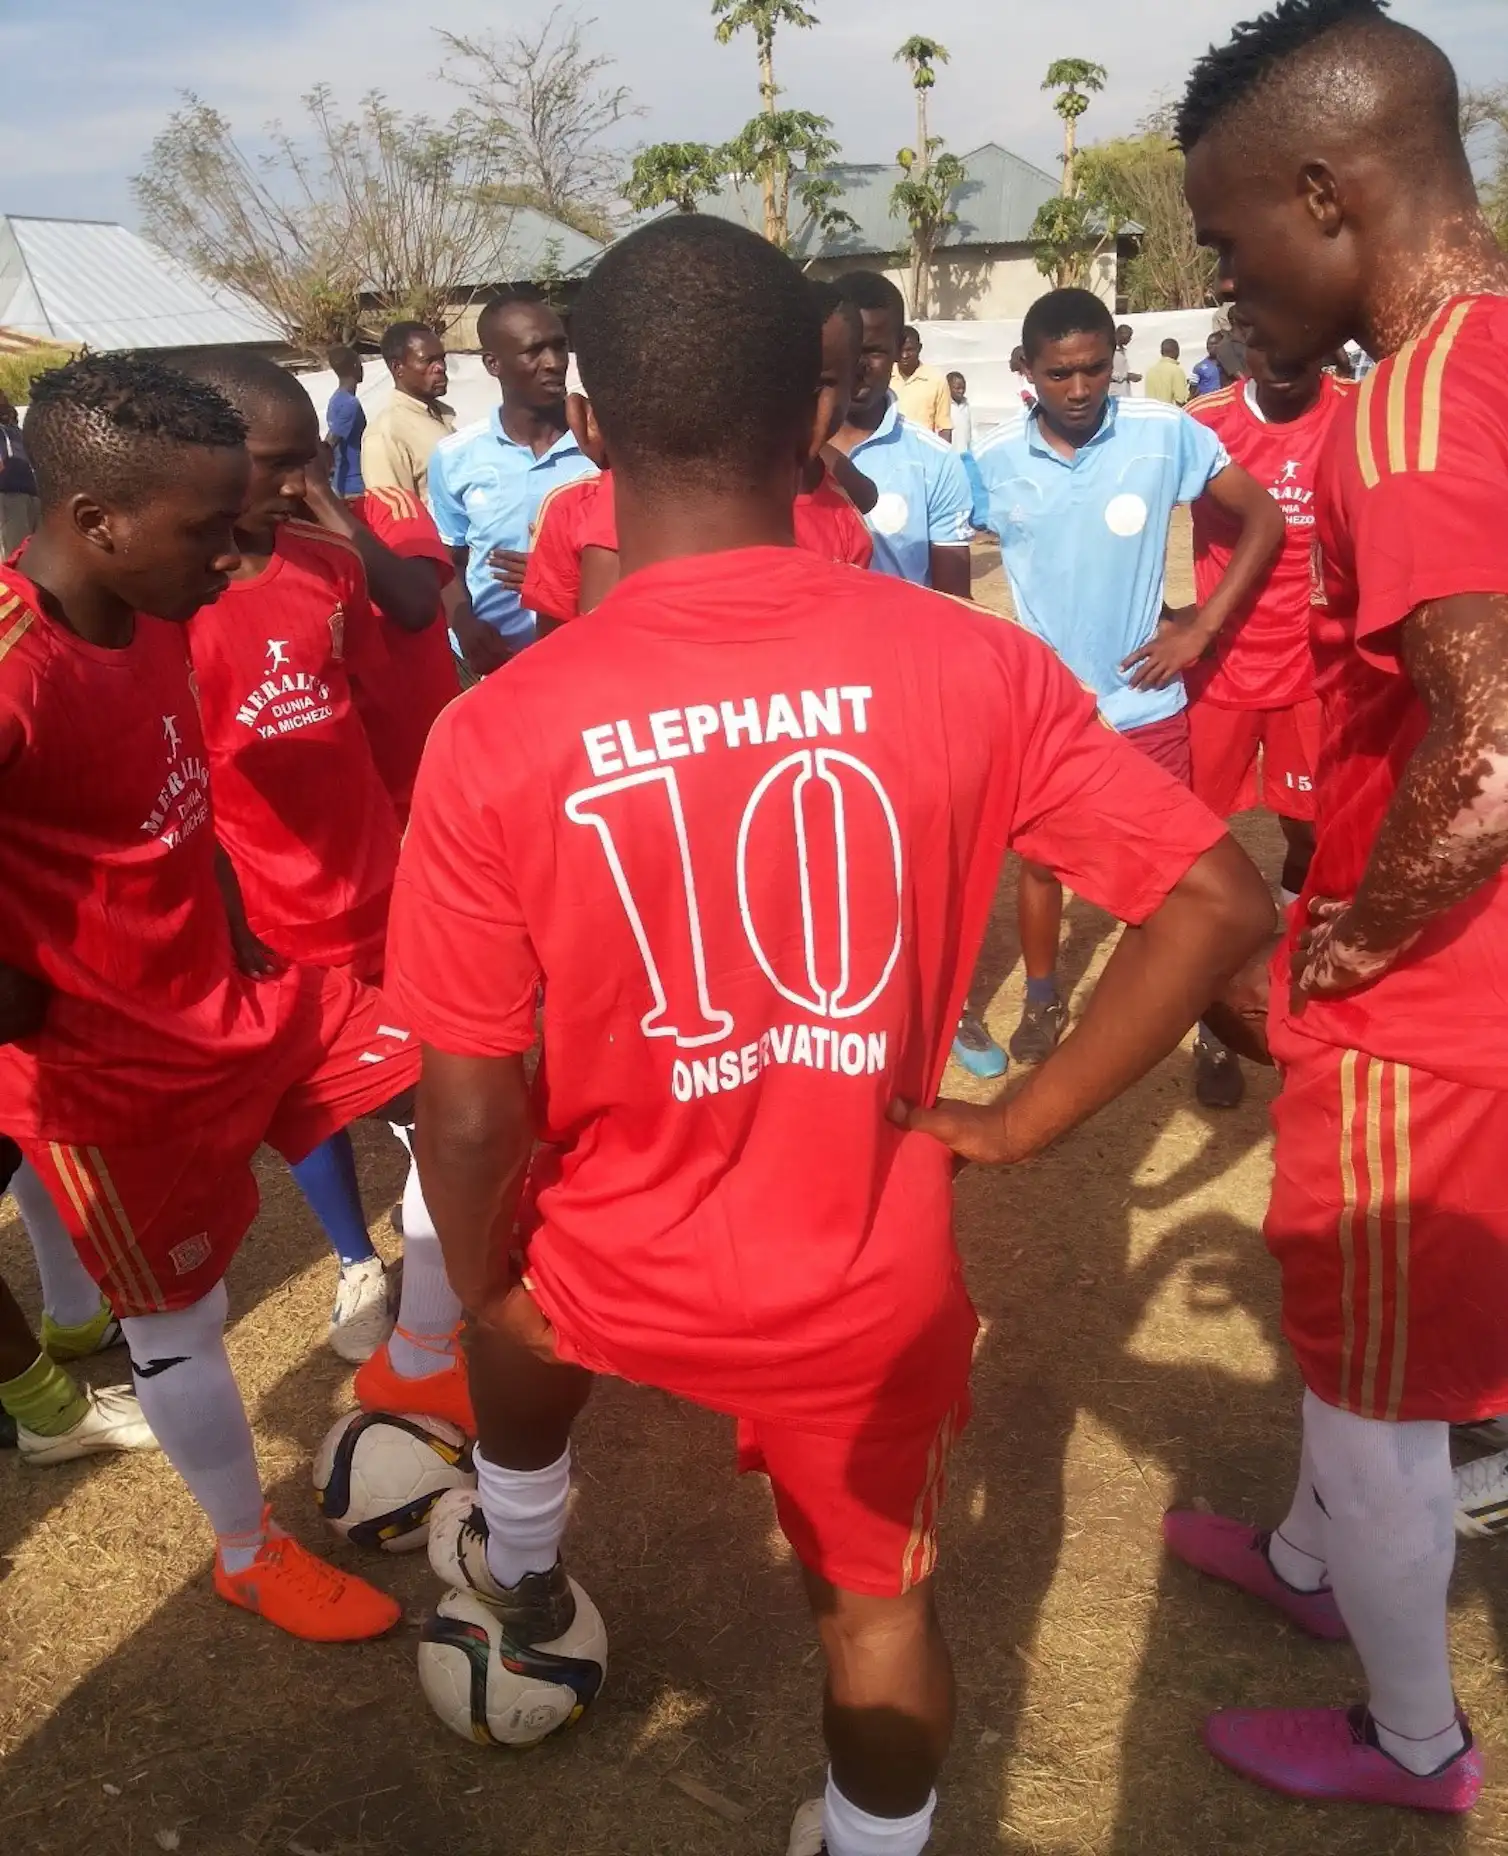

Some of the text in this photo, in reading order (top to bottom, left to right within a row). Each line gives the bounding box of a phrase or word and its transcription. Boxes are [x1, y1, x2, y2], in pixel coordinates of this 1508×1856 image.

[1285, 515, 1315, 525] HEZO
[256, 705, 333, 739] YA MICHEZO
[271, 696, 315, 718] DUNIA
[581, 685, 873, 777] ELEPHANT
[1285, 772, 1312, 791] 15
[565, 747, 902, 1047] 10
[672, 1024, 887, 1102] ONSERVATION
